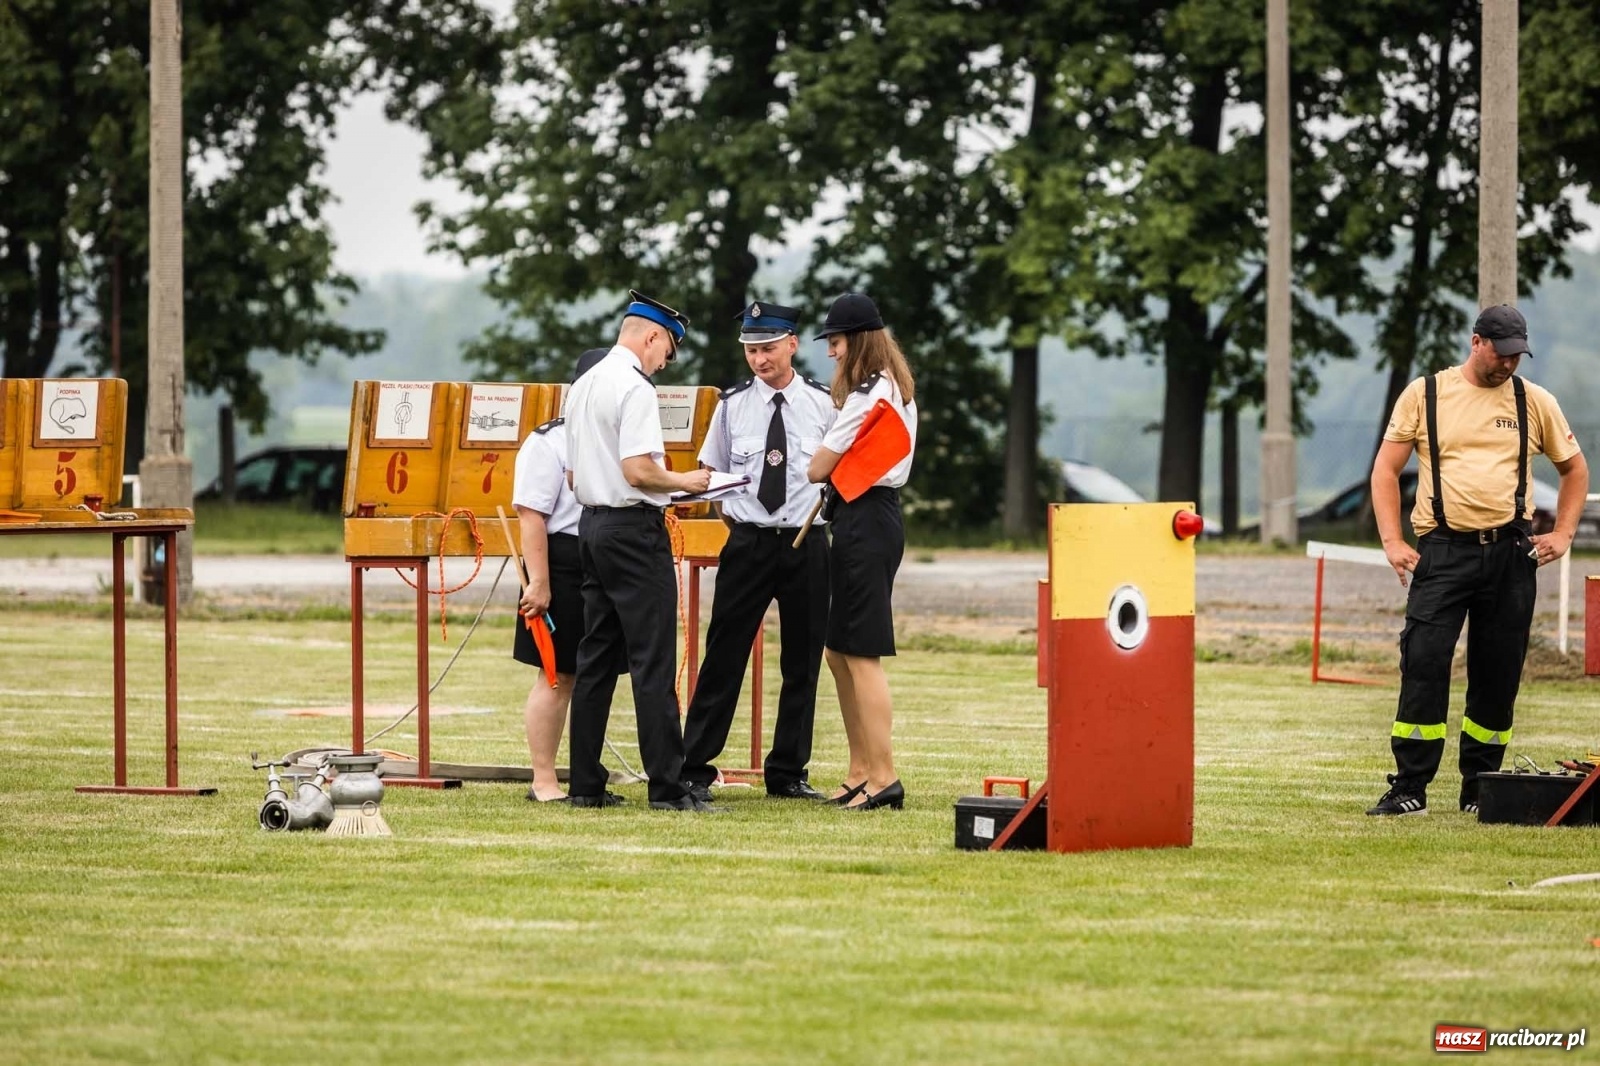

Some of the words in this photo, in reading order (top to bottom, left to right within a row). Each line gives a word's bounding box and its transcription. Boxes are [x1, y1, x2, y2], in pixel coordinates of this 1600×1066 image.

[1496, 419, 1518, 430] STRA
[54, 451, 77, 496] 5
[386, 451, 409, 494] 6
[481, 452, 500, 494] 7
